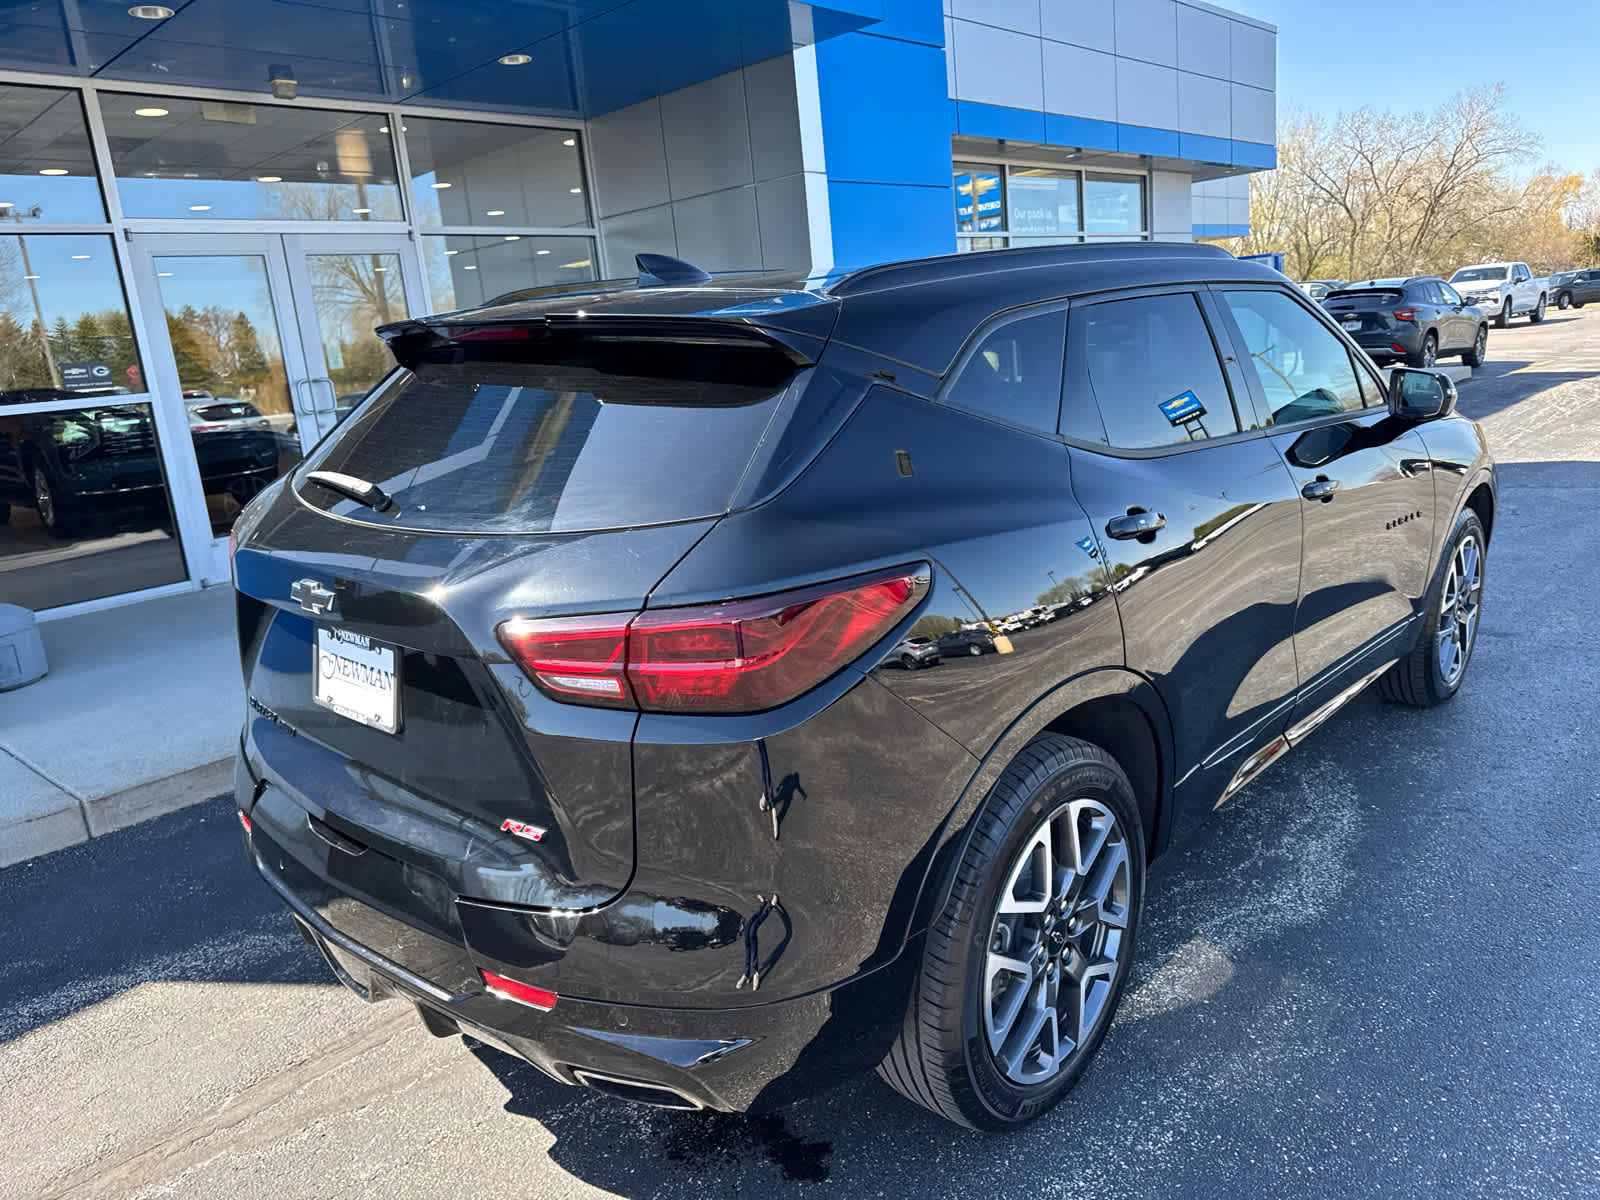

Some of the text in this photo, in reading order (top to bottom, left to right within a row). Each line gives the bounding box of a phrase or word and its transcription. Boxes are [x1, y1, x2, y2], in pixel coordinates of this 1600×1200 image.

[334, 629, 370, 648] NEWMAN
[320, 652, 397, 691] NEWMAN
[500, 818, 547, 842] RS
